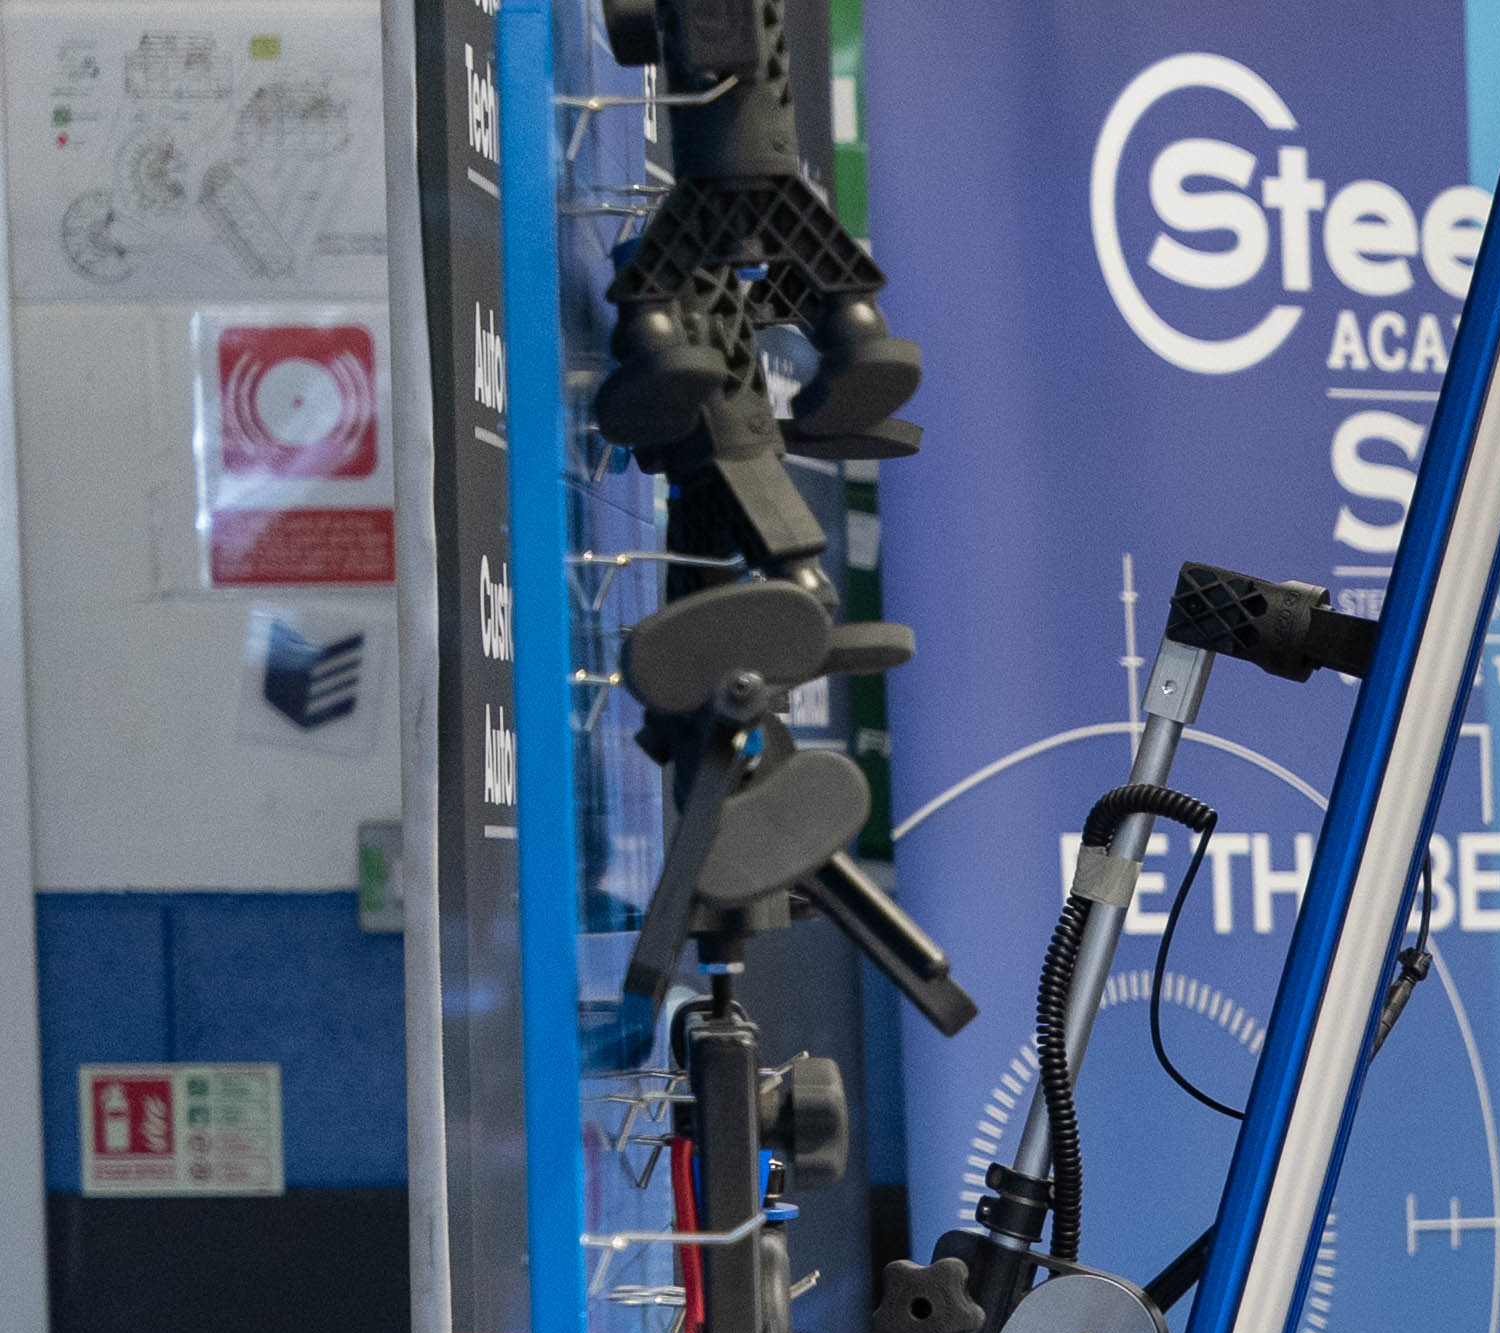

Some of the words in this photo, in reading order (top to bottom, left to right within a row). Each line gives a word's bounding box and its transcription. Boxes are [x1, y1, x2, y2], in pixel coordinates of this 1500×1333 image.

[464, 43, 500, 164] Tech
[1147, 137, 1494, 300] Stee
[474, 301, 508, 415] Auto
[480, 554, 515, 663] Cust
[484, 703, 517, 806] Auto
[1191, 833, 1314, 934] TH
